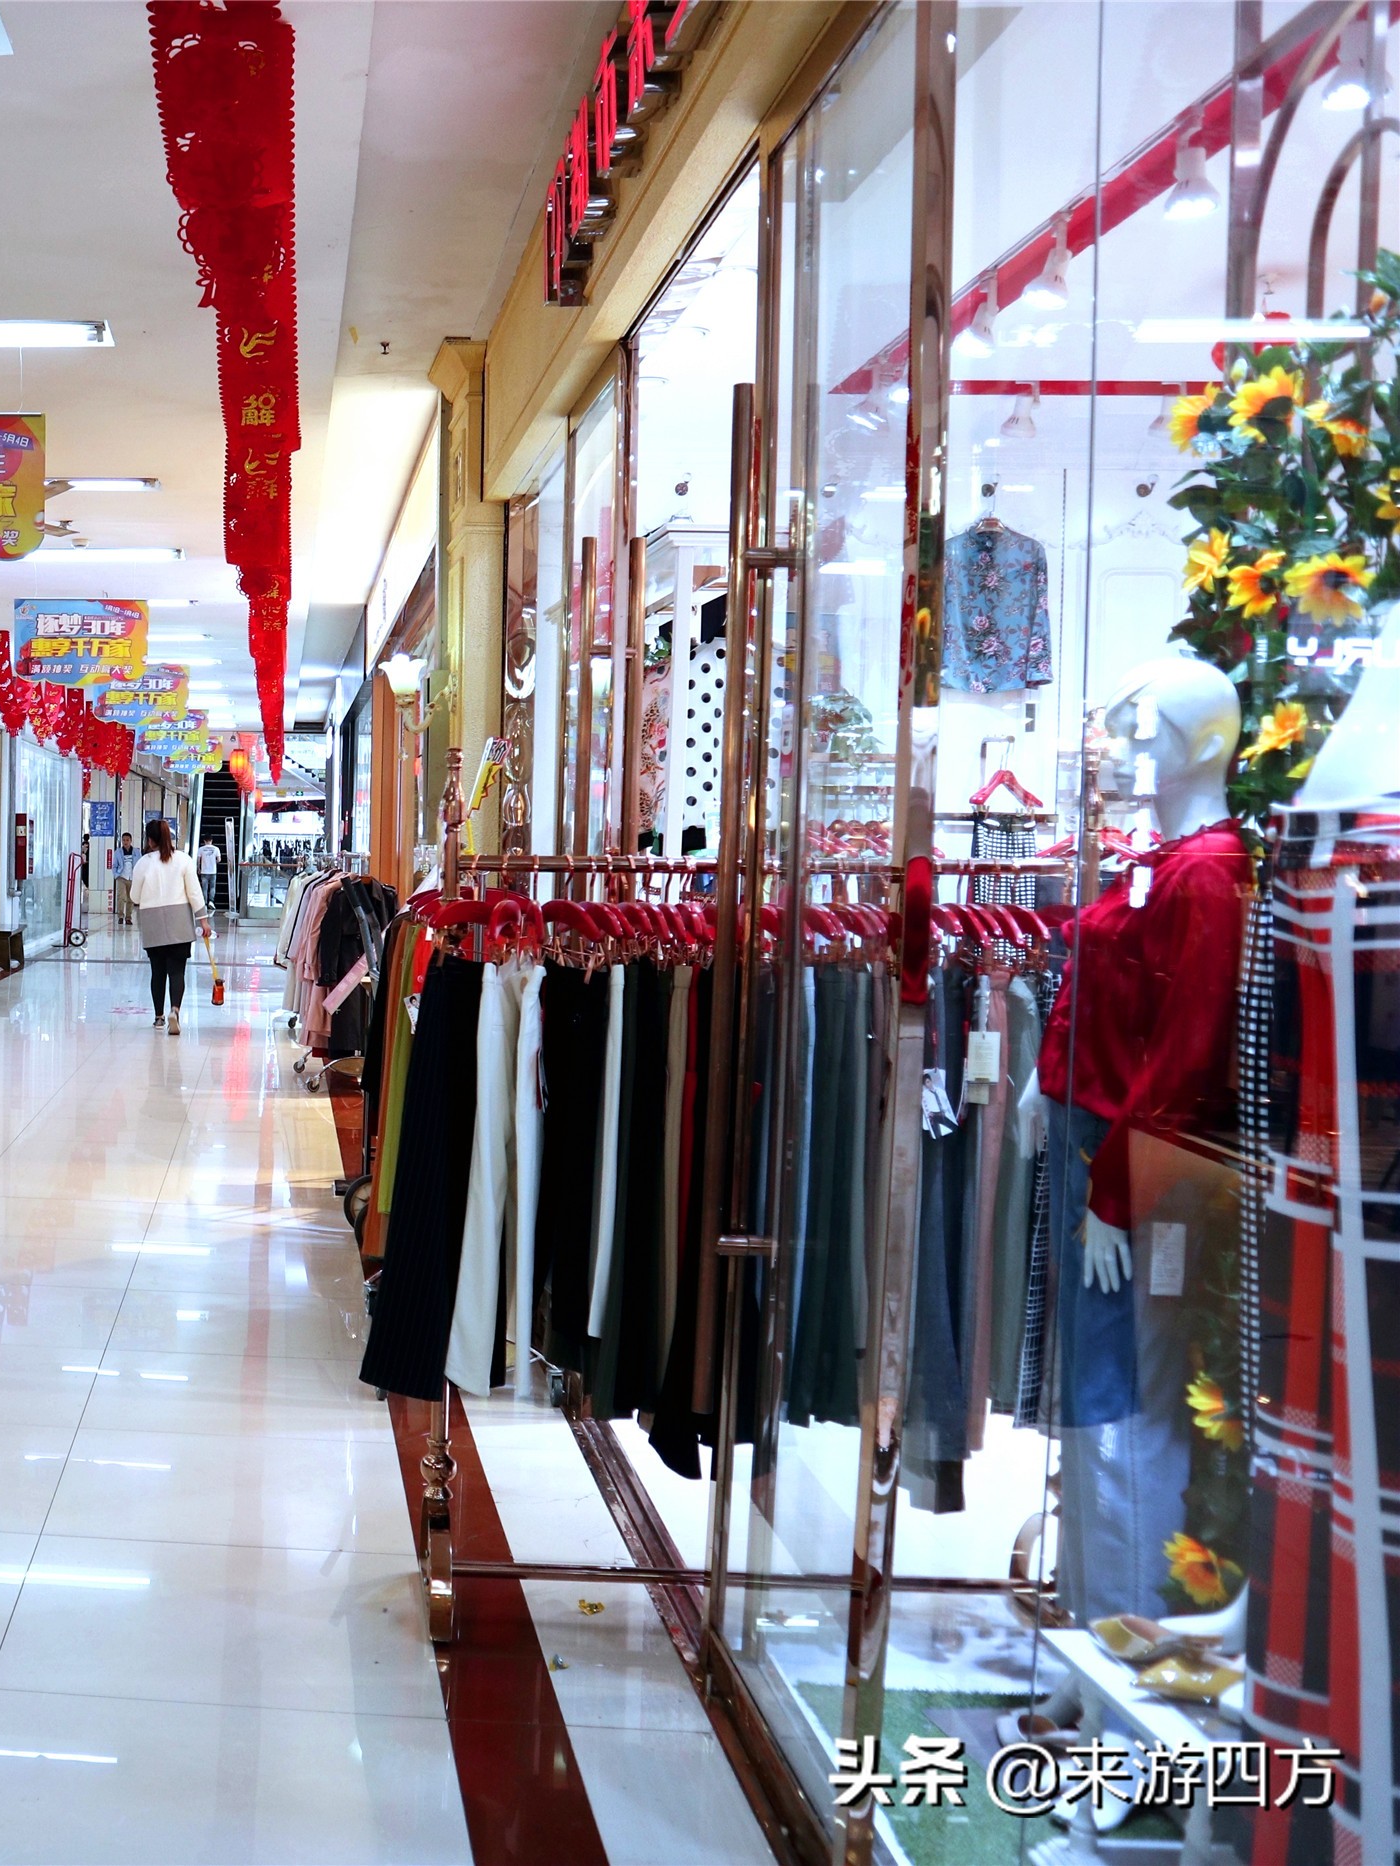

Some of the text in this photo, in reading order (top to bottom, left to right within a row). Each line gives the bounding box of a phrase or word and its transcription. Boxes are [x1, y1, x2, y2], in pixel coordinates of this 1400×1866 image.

[36, 613, 127, 637] 逐梦30年
[30, 638, 132, 658] 惠享千万家
[30, 664, 73, 674] 满额抽奖
[105, 692, 178, 706] 惠享千万家
